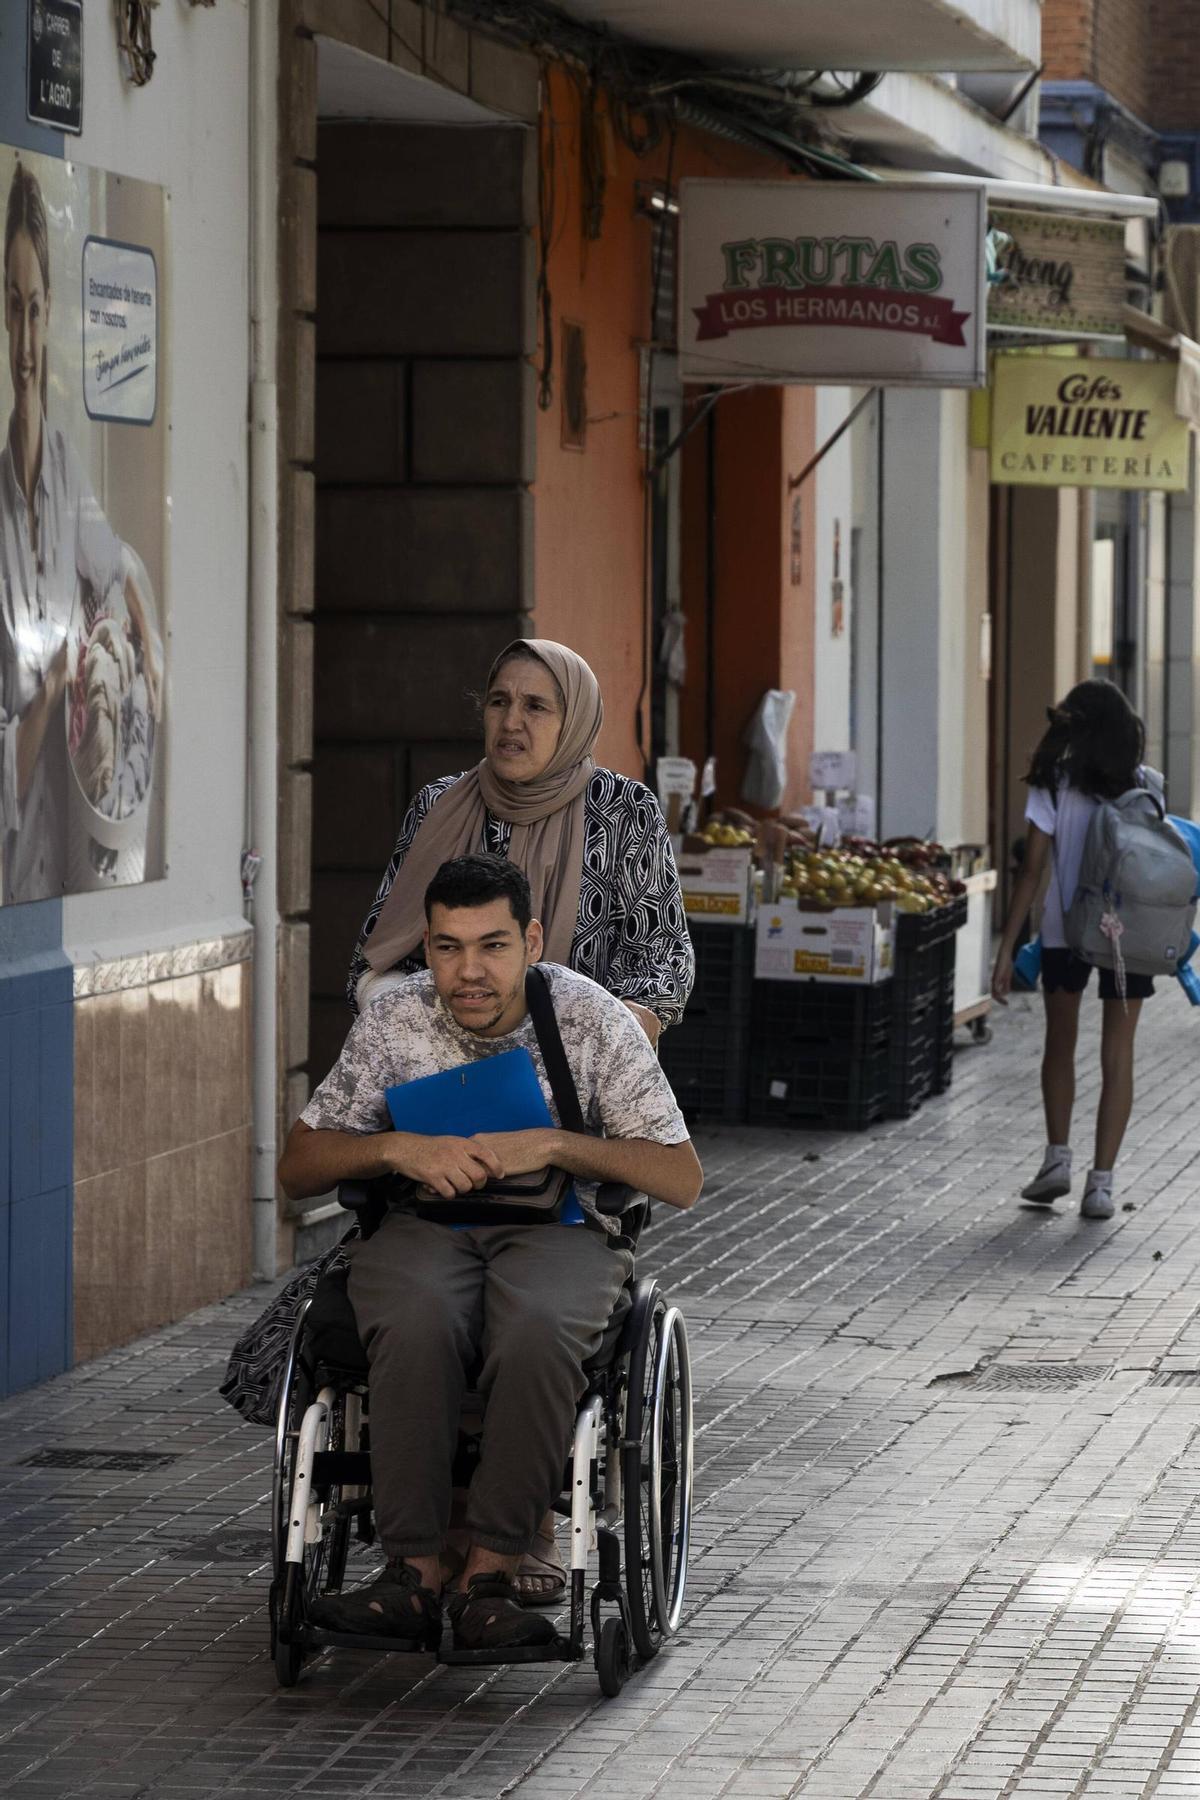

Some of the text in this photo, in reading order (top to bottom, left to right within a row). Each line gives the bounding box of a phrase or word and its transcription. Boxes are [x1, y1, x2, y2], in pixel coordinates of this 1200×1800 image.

[46, 12, 70, 36] CARRER
[52, 48, 62, 68] DE
[721, 235, 943, 294] FRUTAS
[89, 277, 122, 301] Encantados
[123, 283, 131, 302] de
[89, 309, 100, 324] con
[720, 298, 768, 323] LOS
[775, 297, 920, 327] HERMANOS
[1057, 373, 1123, 404] Cafés
[1025, 404, 1150, 441] VALIENTE
[1001, 450, 1173, 478] CAFETERÍA
